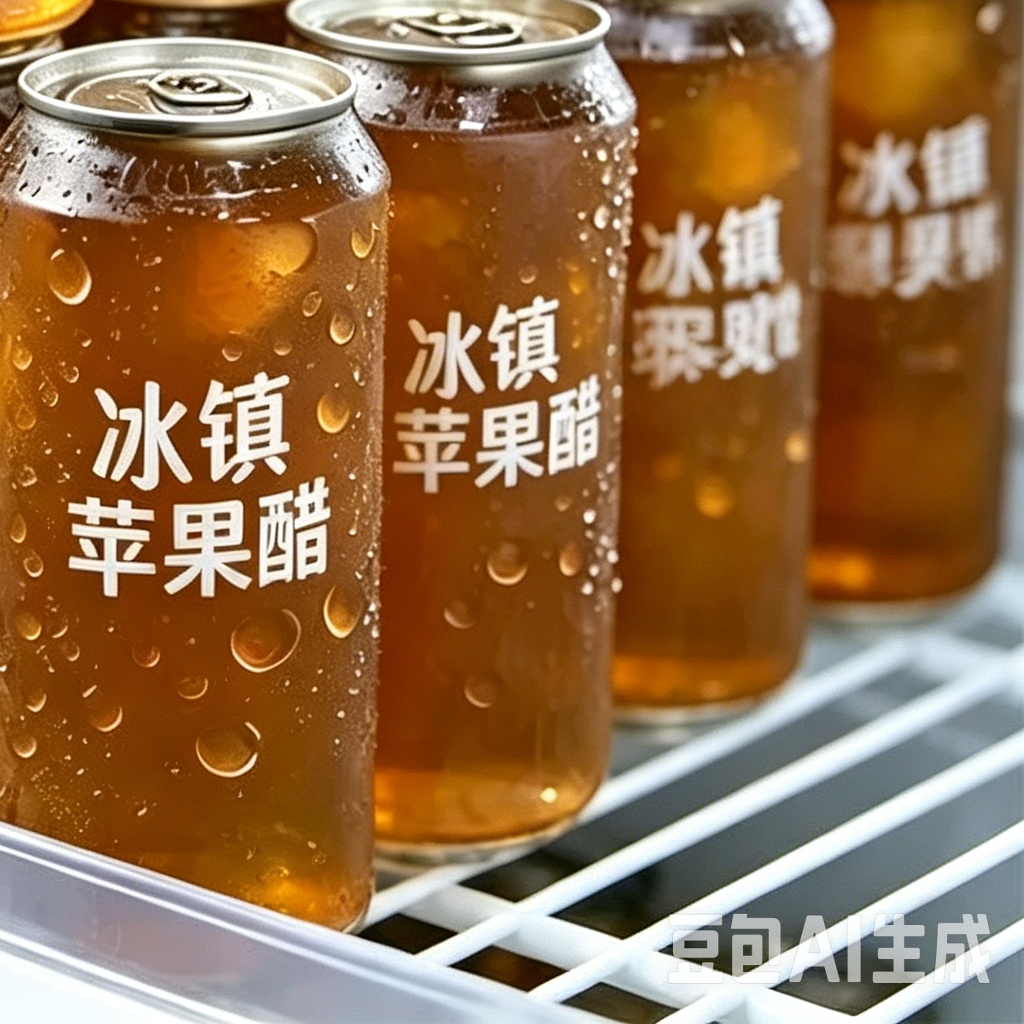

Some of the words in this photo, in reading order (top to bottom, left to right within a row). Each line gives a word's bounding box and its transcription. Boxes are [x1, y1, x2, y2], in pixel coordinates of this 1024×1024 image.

[405, 296, 560, 400] 冰镇
[92, 371, 291, 491] 冰镇
[394, 374, 602, 494] 苹果醋
[67, 477, 330, 598] 苹果醋
